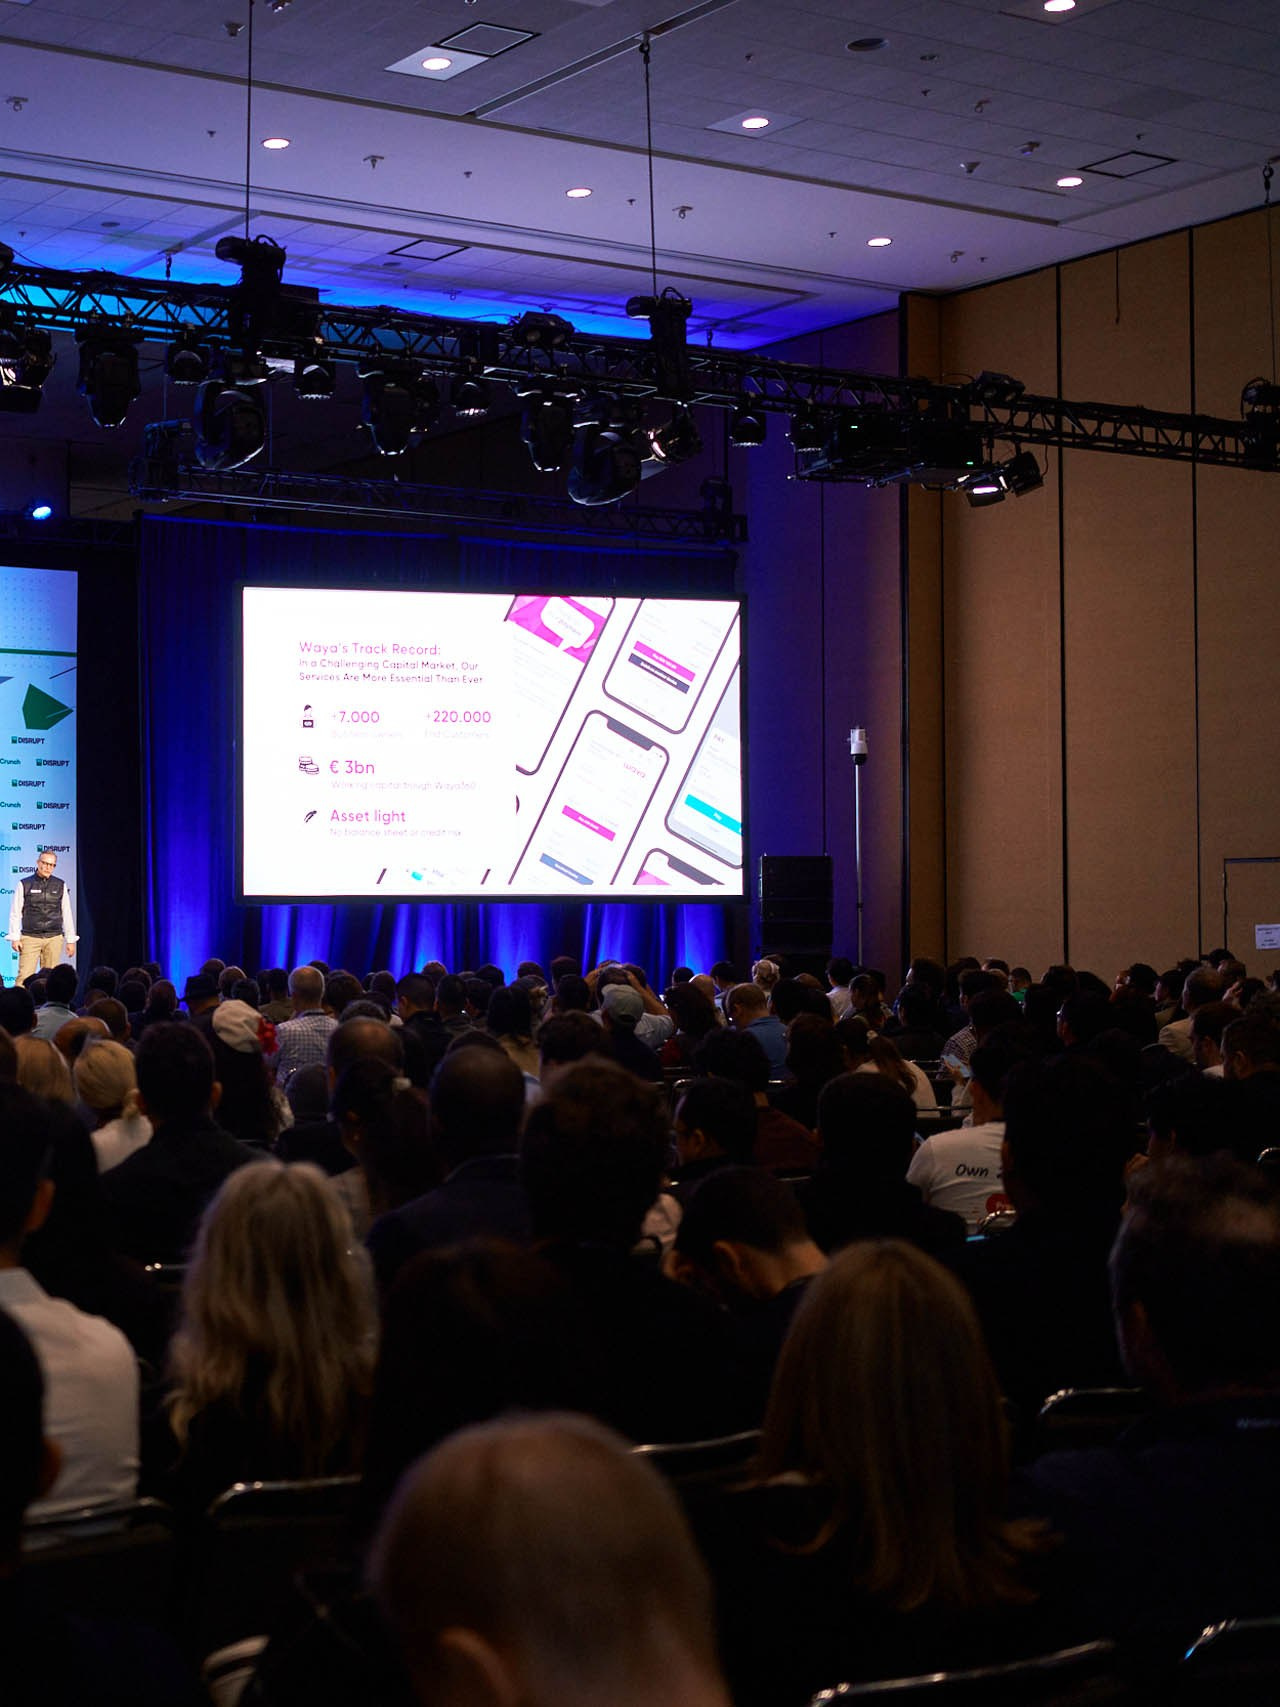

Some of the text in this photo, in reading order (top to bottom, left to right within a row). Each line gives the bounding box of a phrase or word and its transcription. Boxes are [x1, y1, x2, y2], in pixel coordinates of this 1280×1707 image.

[299, 642, 441, 655] Waya's Track Record:
[320, 659, 379, 670] Challenging
[382, 660, 418, 670] Capital
[422, 662, 458, 671] Market,
[461, 662, 478, 670] Our
[299, 673, 483, 684] Services Are More Essential Than Ever
[329, 760, 375, 774] € 3bn
[330, 809, 406, 825] Asset light
[956, 1164, 988, 1177] Own
